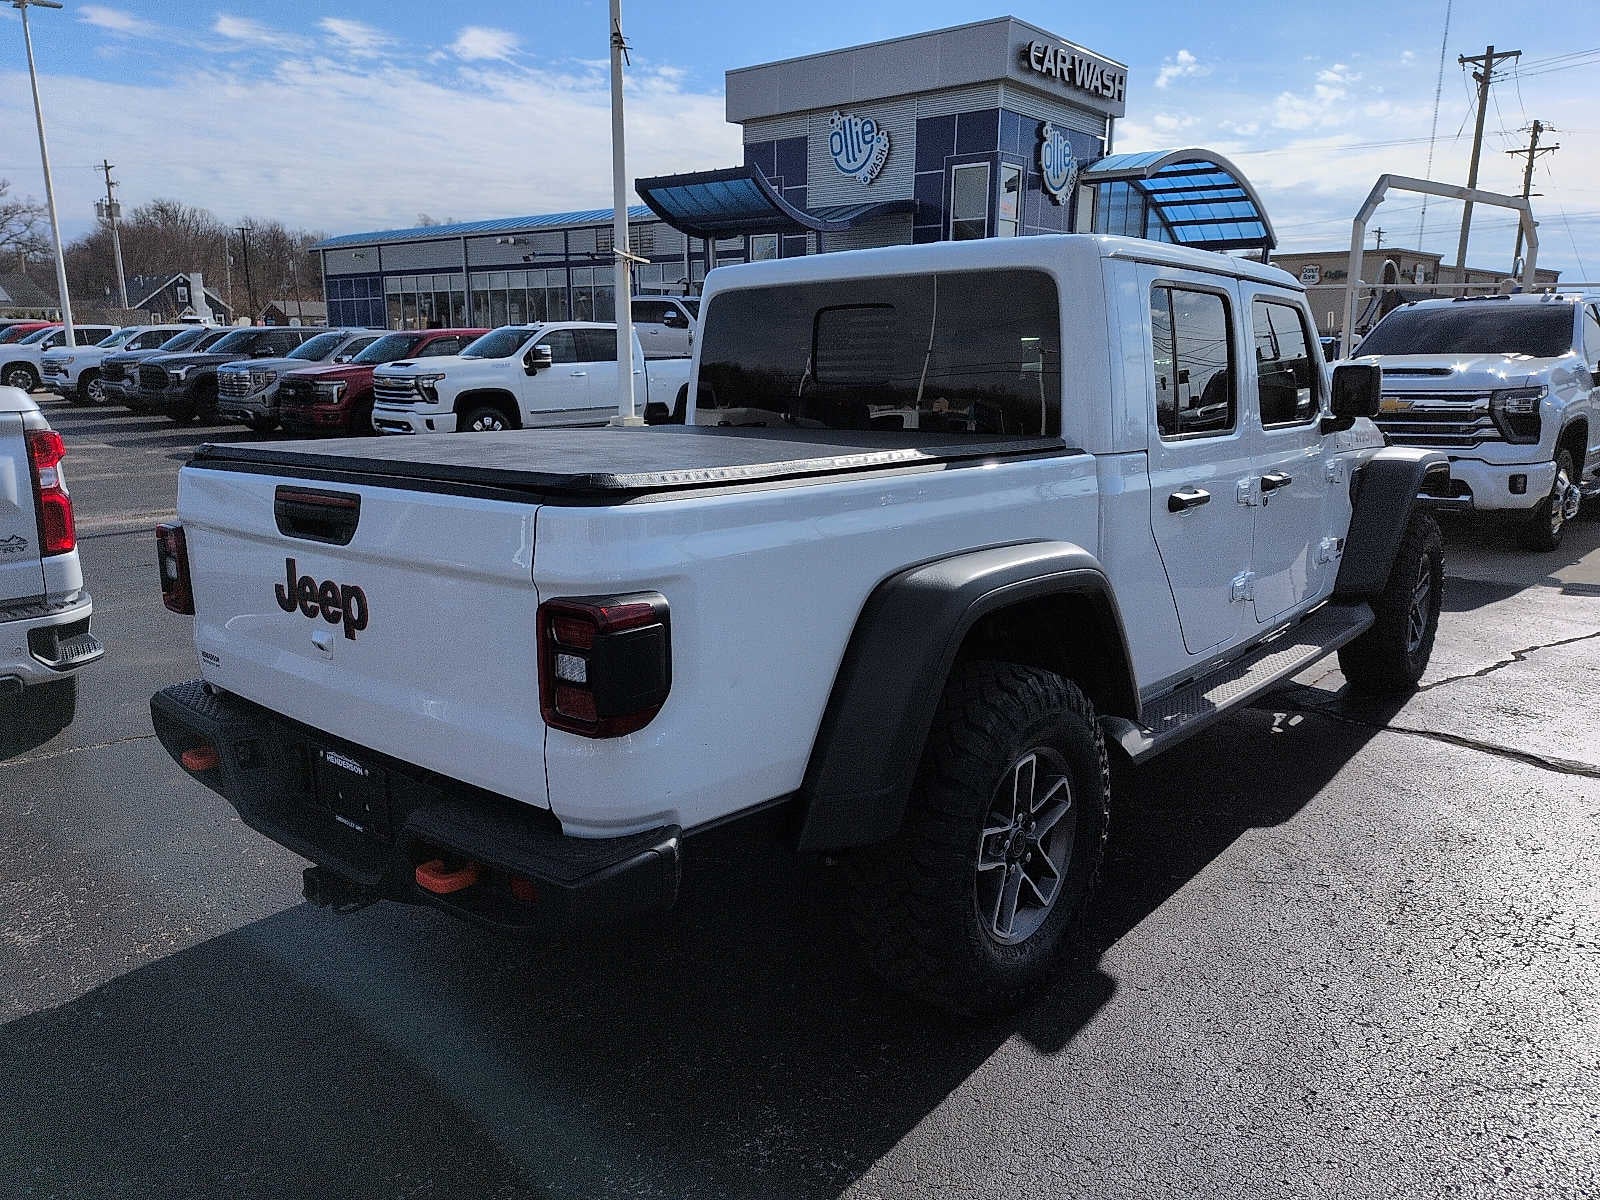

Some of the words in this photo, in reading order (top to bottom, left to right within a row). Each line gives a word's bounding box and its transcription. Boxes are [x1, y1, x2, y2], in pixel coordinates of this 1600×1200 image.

[1029, 40, 1070, 81] CAR
[1074, 55, 1126, 102] WASH
[829, 118, 875, 164] ollie
[867, 148, 886, 177] WASH
[1044, 131, 1071, 180] ollie
[275, 557, 368, 640] Jeep
[326, 754, 364, 775] HENDERSON
